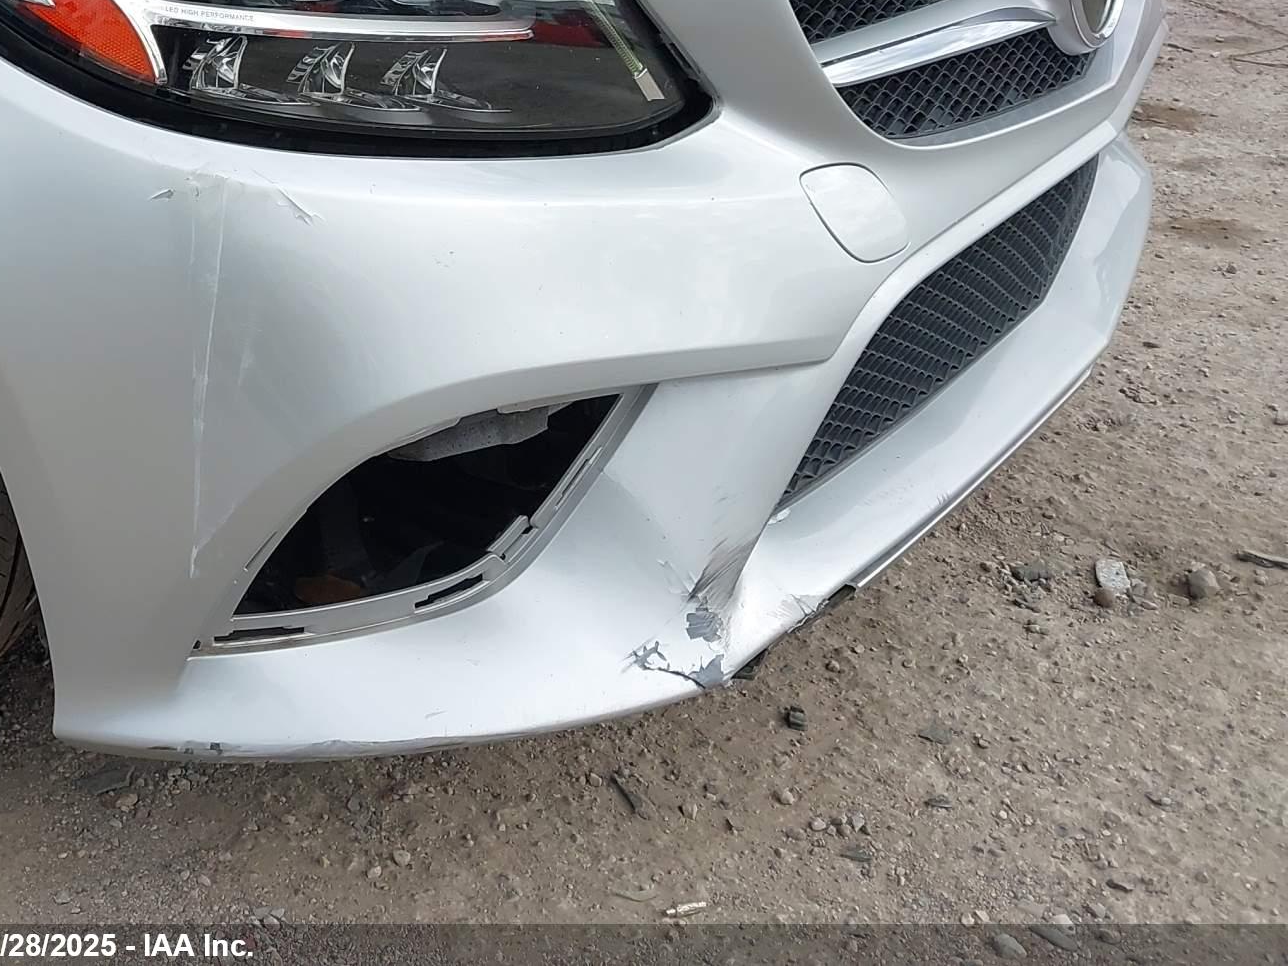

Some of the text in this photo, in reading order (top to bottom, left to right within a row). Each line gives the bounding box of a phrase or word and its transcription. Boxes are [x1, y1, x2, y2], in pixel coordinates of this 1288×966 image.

[164, 6, 254, 22] LED HIGH PERFORMANCE
